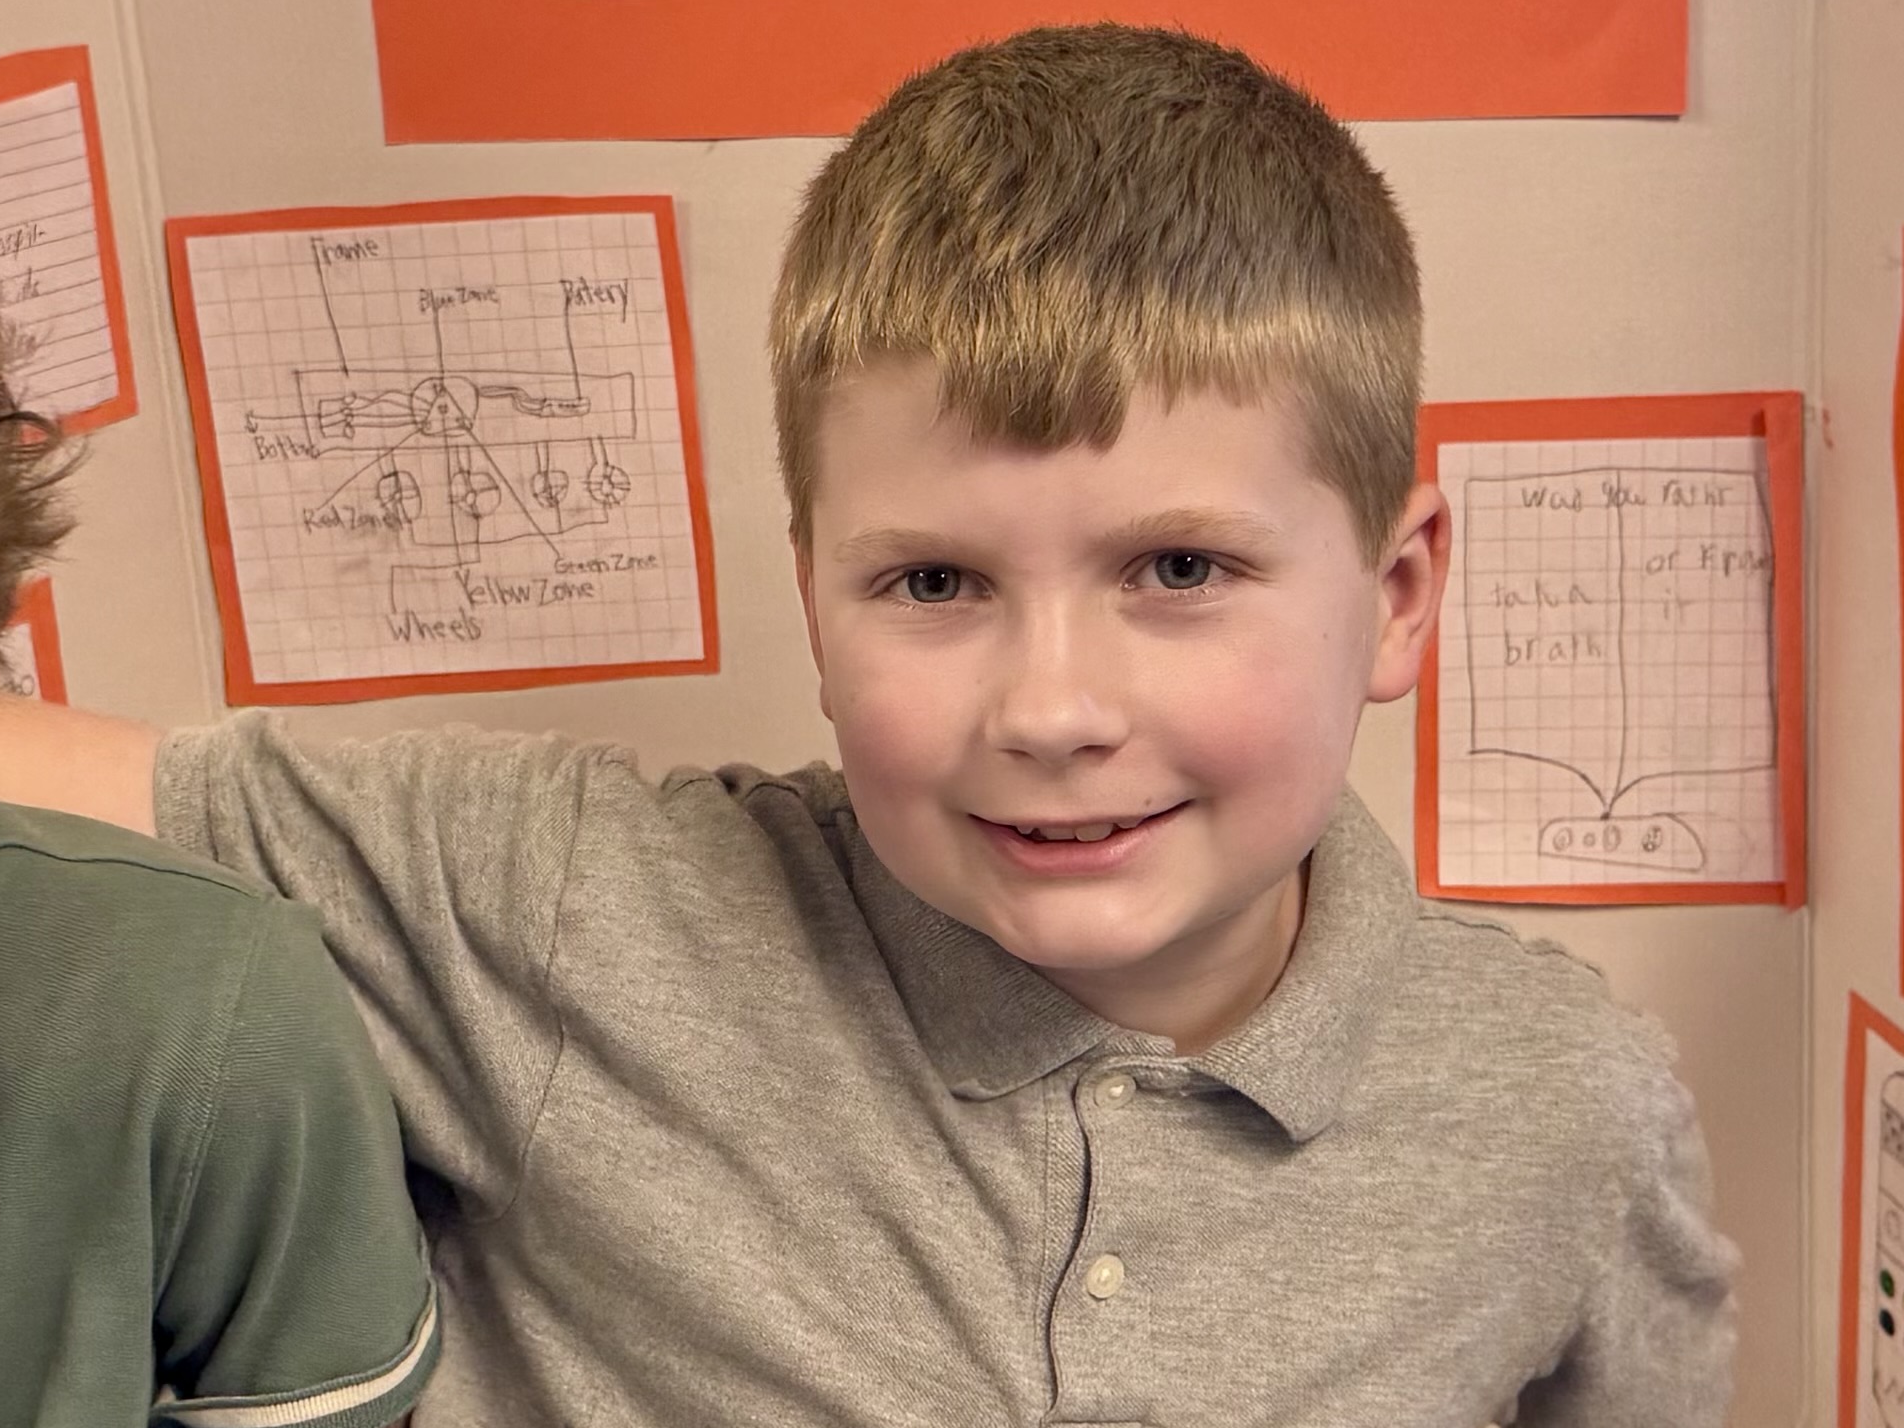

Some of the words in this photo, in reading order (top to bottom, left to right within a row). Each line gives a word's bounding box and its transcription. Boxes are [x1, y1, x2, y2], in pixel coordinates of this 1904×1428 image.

[309, 235, 380, 267] Frame
[301, 503, 346, 535] Red
[1645, 548, 1679, 576] or
[455, 568, 532, 610] Yellow
[531, 576, 596, 607] Zone
[385, 606, 483, 643] Wheels
